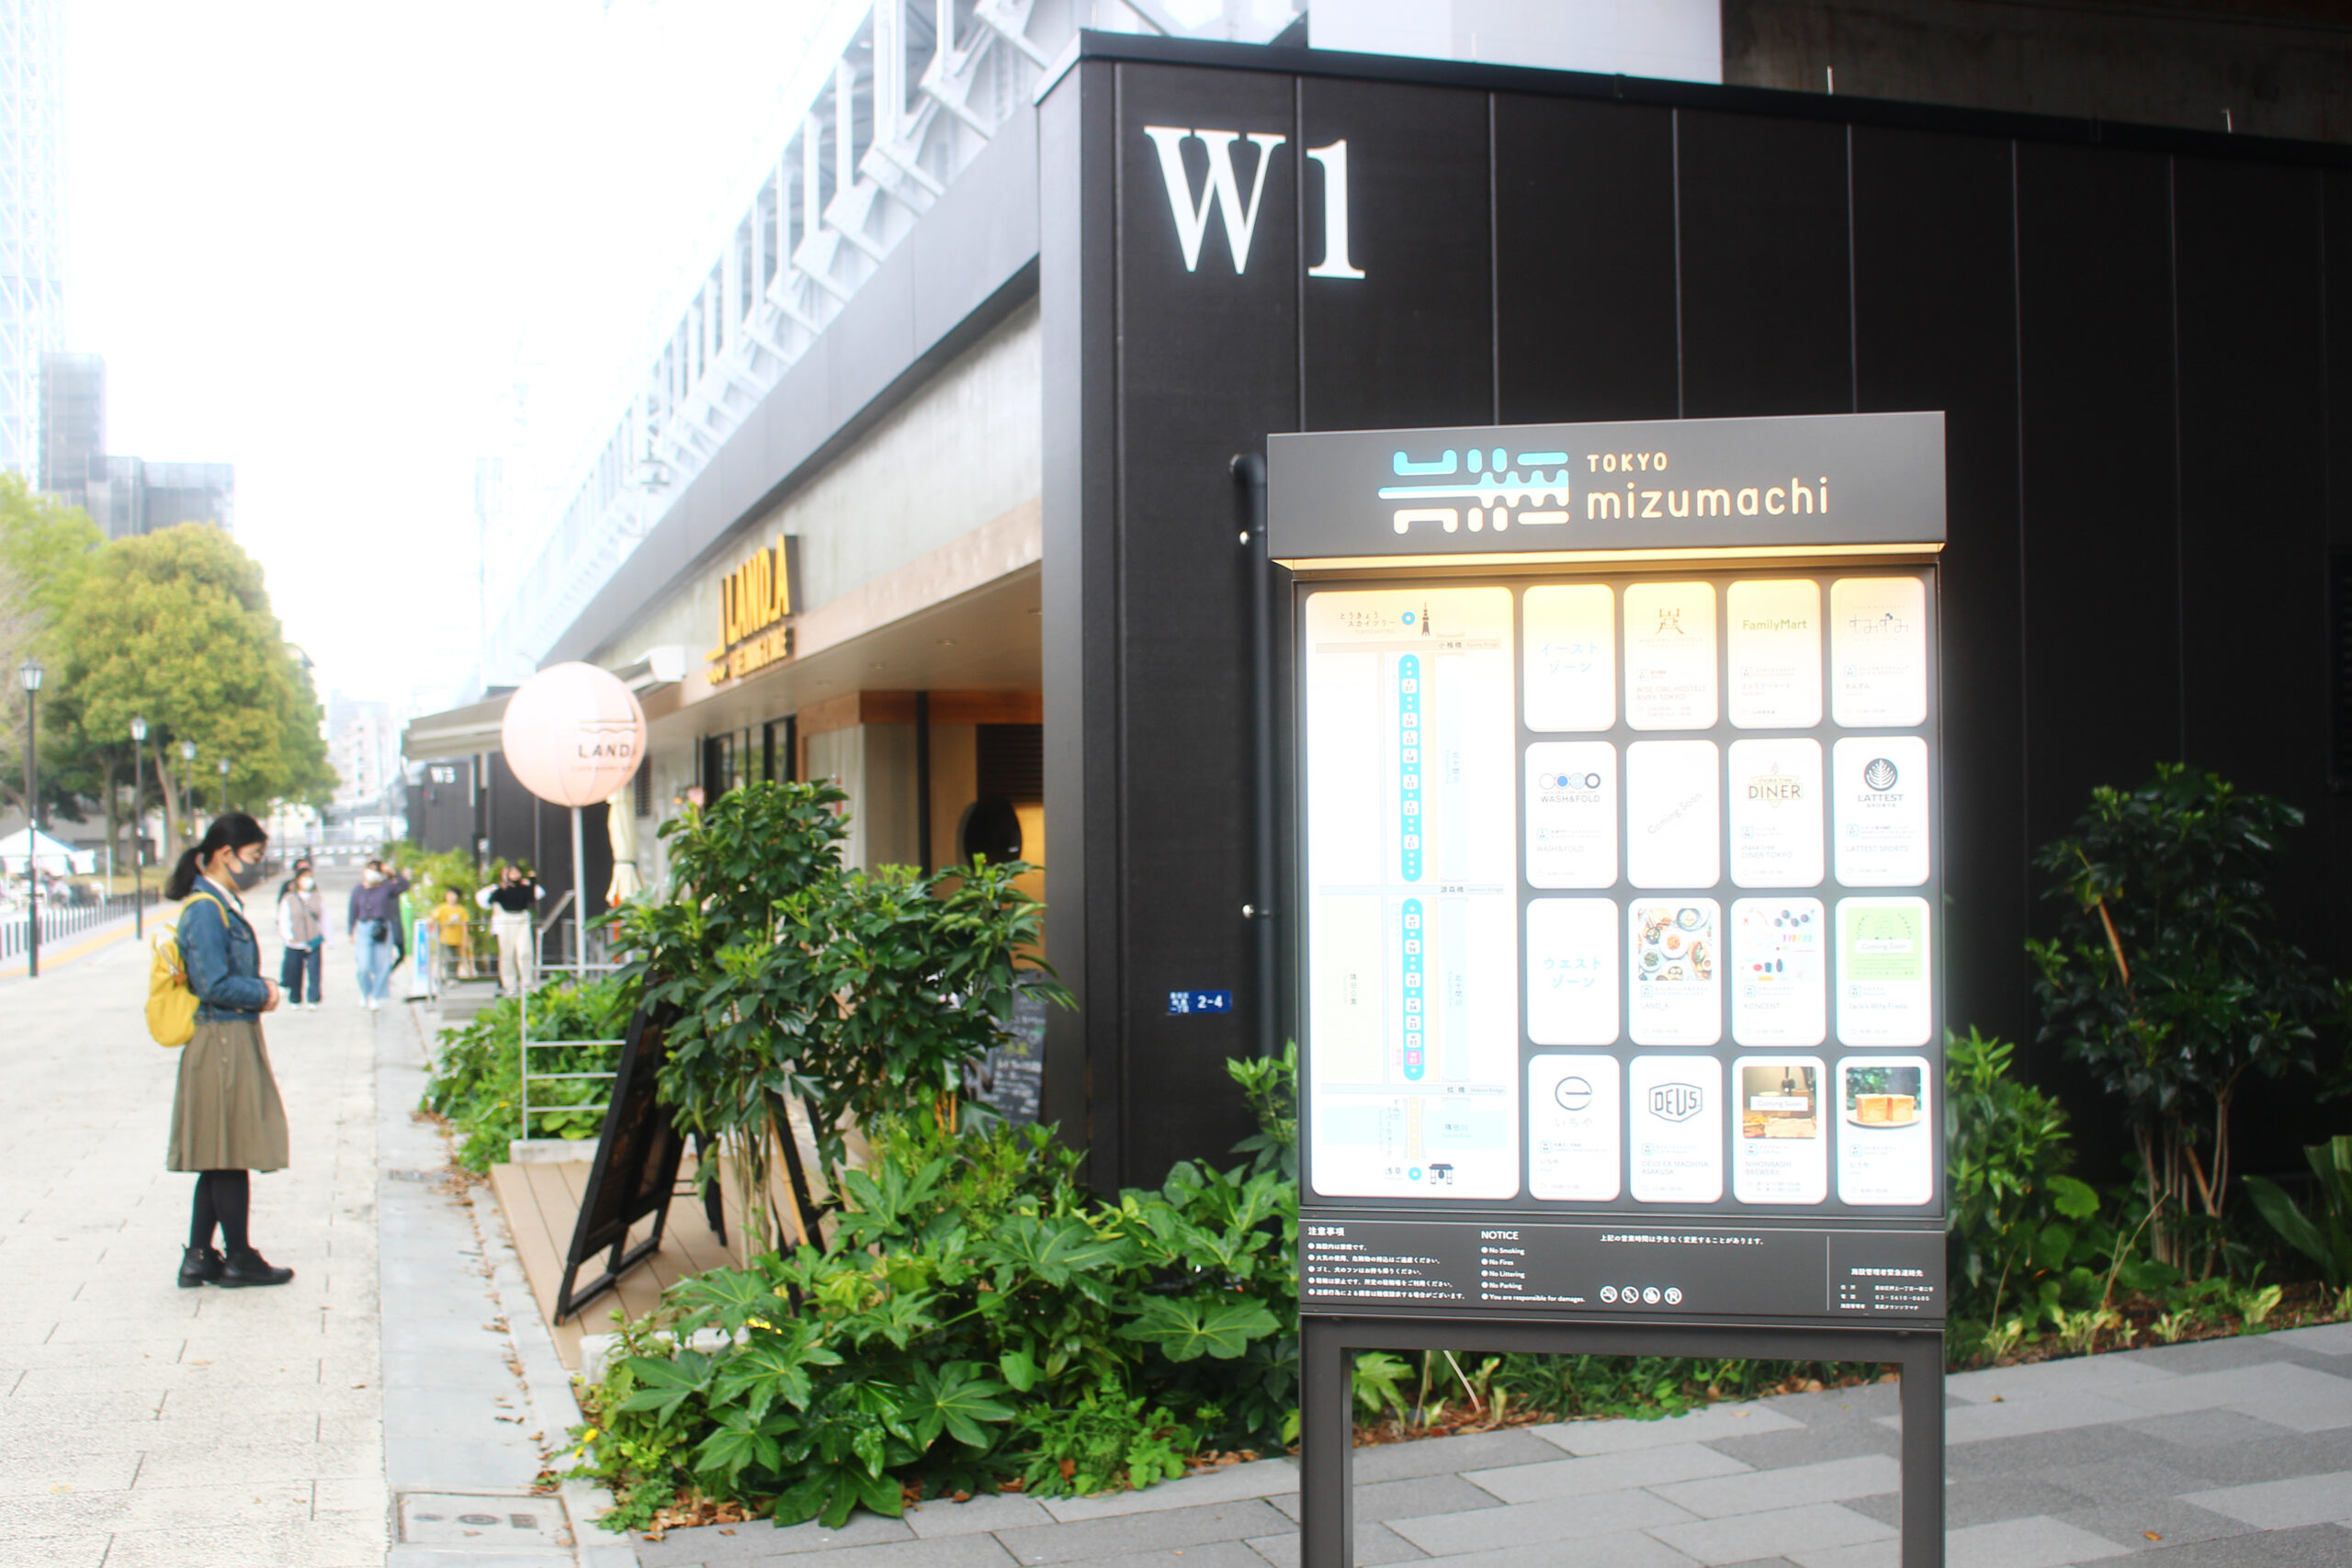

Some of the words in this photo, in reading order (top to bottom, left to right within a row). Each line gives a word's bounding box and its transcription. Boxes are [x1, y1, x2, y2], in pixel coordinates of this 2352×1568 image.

[1587, 451, 1668, 473] TOKYO
[1587, 477, 1828, 520] mizumachi
[1742, 619, 1807, 632] FamilyMart
[1540, 641, 1598, 655] イースト
[1549, 660, 1593, 675] ゾーン
[1748, 784, 1802, 799] DINER
[1857, 794, 1905, 802] LATTEST
[1540, 795, 1601, 803] WASH&FOLD
[1544, 955, 1601, 970] ウエスト
[1551, 974, 1596, 989] ゾーン
[1197, 995, 1223, 1009] 2-4
[1654, 1088, 1699, 1117] DEUS
[1307, 1226, 1345, 1237] 注意事項
[1481, 1231, 1520, 1240] NOTICE
[1499, 1247, 1526, 1256] Smoking
[1499, 1270, 1526, 1279] Littering
[1499, 1282, 1522, 1291] Parking
[1513, 1294, 1546, 1303] responsible
